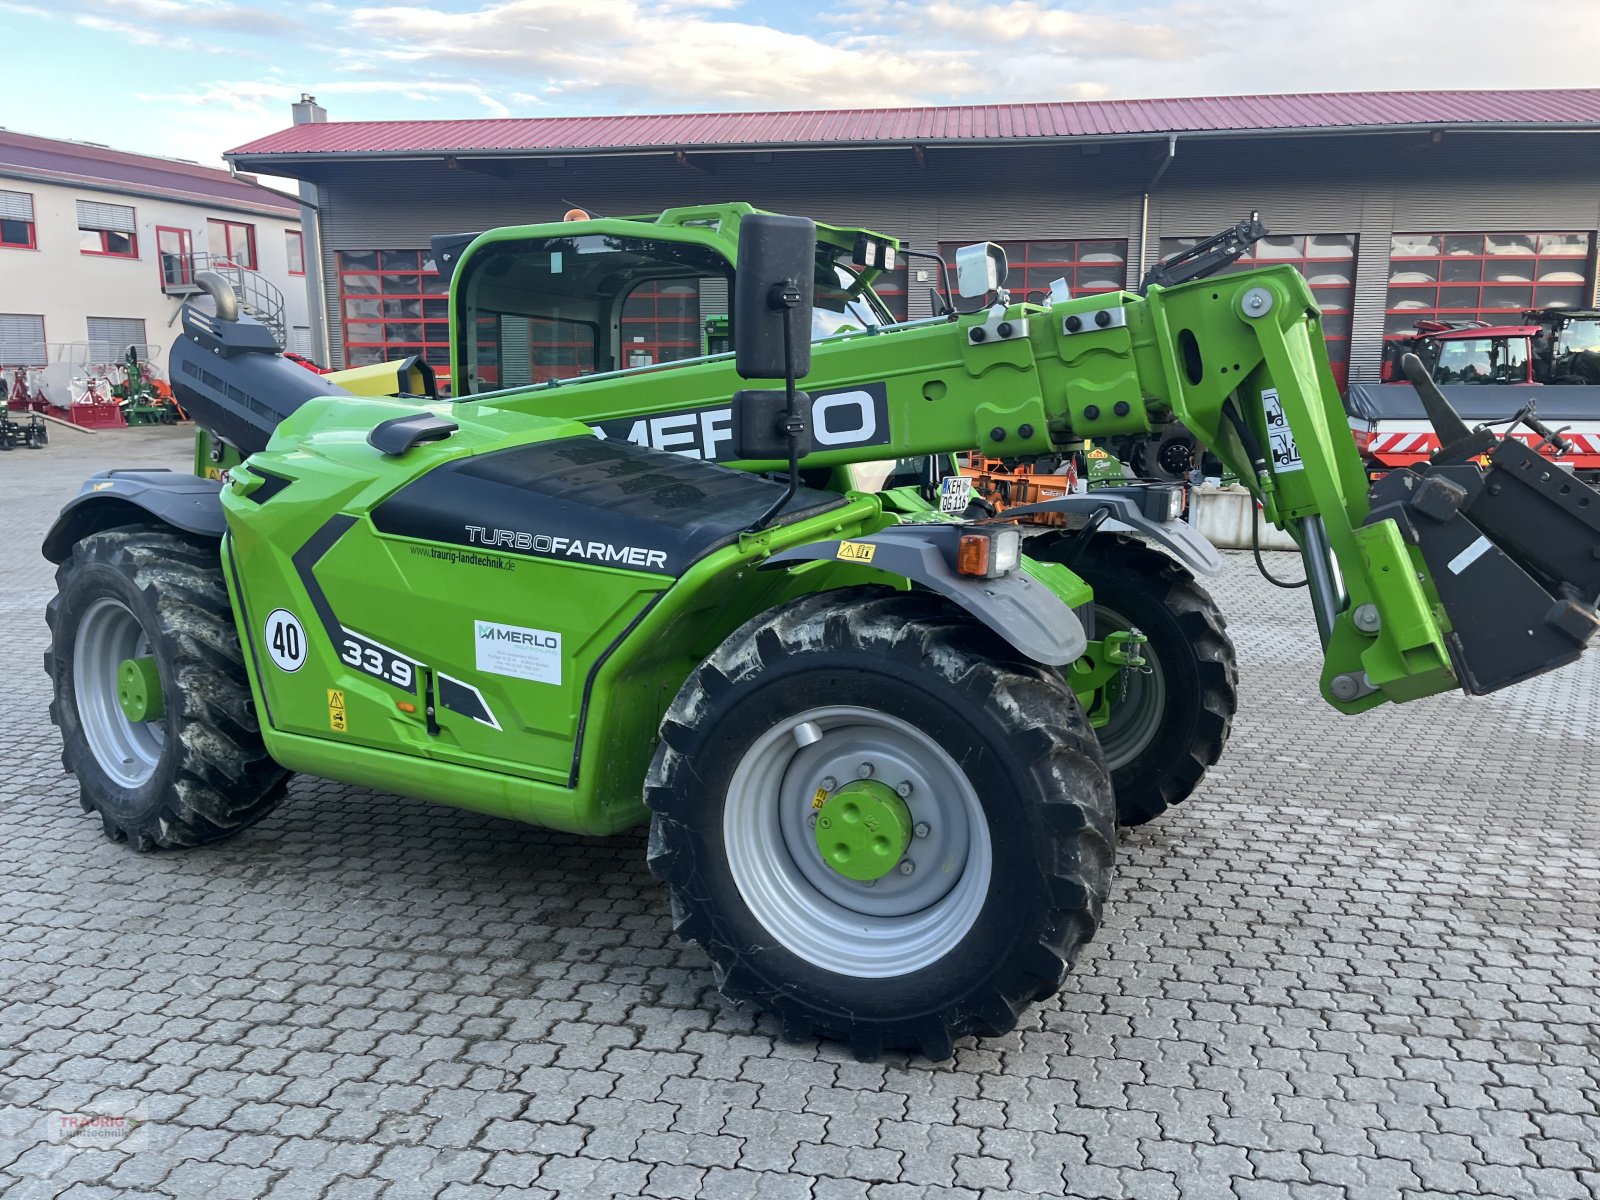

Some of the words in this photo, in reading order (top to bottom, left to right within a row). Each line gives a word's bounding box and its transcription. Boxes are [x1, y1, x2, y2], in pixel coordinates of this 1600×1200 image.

[947, 480, 962, 494] KEH
[410, 546, 516, 572] www.traurig-landtechnik.de
[465, 525, 668, 568] TURBOFARMER
[273, 621, 299, 660] 40
[497, 629, 557, 649] MERLO
[342, 639, 412, 687] 33.9
